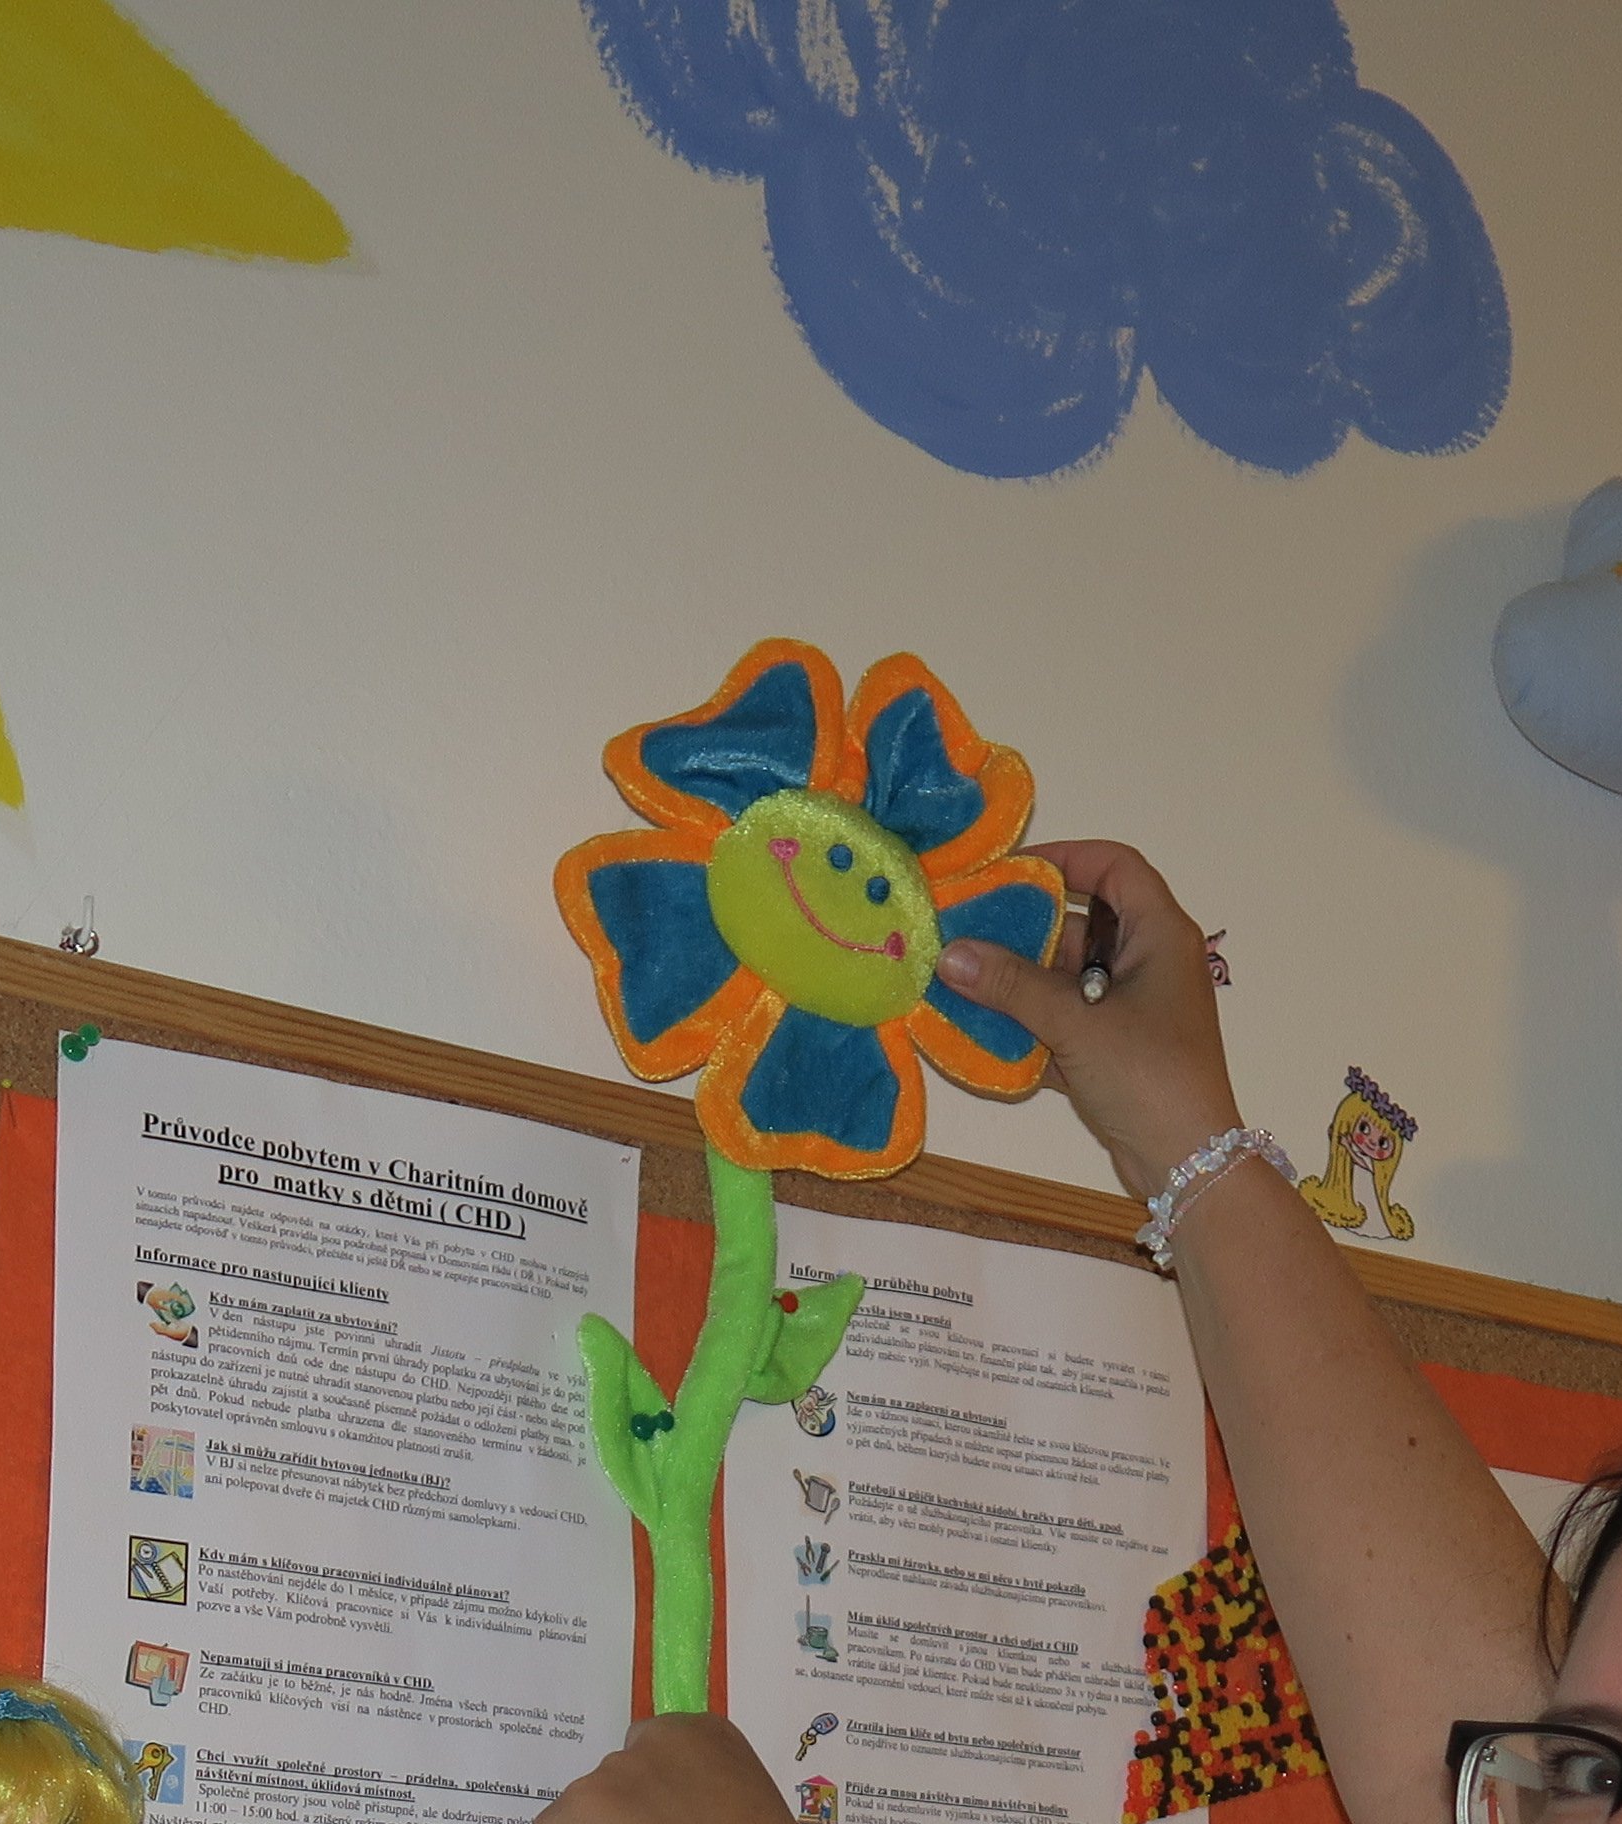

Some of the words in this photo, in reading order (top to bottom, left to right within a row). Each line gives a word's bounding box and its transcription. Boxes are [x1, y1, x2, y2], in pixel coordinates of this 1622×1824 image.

[143, 1111, 254, 1153] Průvodce
[262, 1138, 360, 1173] pobytem
[368, 1158, 379, 1177] v
[388, 1157, 504, 1200] Charitním
[511, 1180, 588, 1216] domově
[219, 1165, 258, 1188] pro
[273, 1175, 343, 1207] matky
[351, 1189, 362, 1206] s
[369, 1187, 432, 1219] dětmi
[455, 1202, 511, 1233] CHD
[135, 1243, 215, 1272] Informace
[220, 1261, 248, 1277] pro
[252, 1266, 335, 1291] nastupující
[339, 1277, 388, 1303] klienty
[199, 1650, 271, 1673] Nepamatuji
[273, 1660, 283, 1672] si
[286, 1661, 322, 1676] jména
[325, 1667, 390, 1684] pracovníků
[392, 1674, 400, 1685] v
[402, 1672, 432, 1689] CHD.
[195, 1767, 253, 1785] návštěvní
[254, 1773, 308, 1792] místnost,
[310, 1778, 361, 1796] úklidová
[363, 1784, 415, 1801] místnost.
[196, 1748, 225, 1764] Chci
[233, 1754, 268, 1769] využít
[276, 1758, 325, 1774] společné
[333, 1765, 382, 1783] prostory
[405, 1771, 455, 1789] prádelna,
[465, 1778, 530, 1795] společenská
